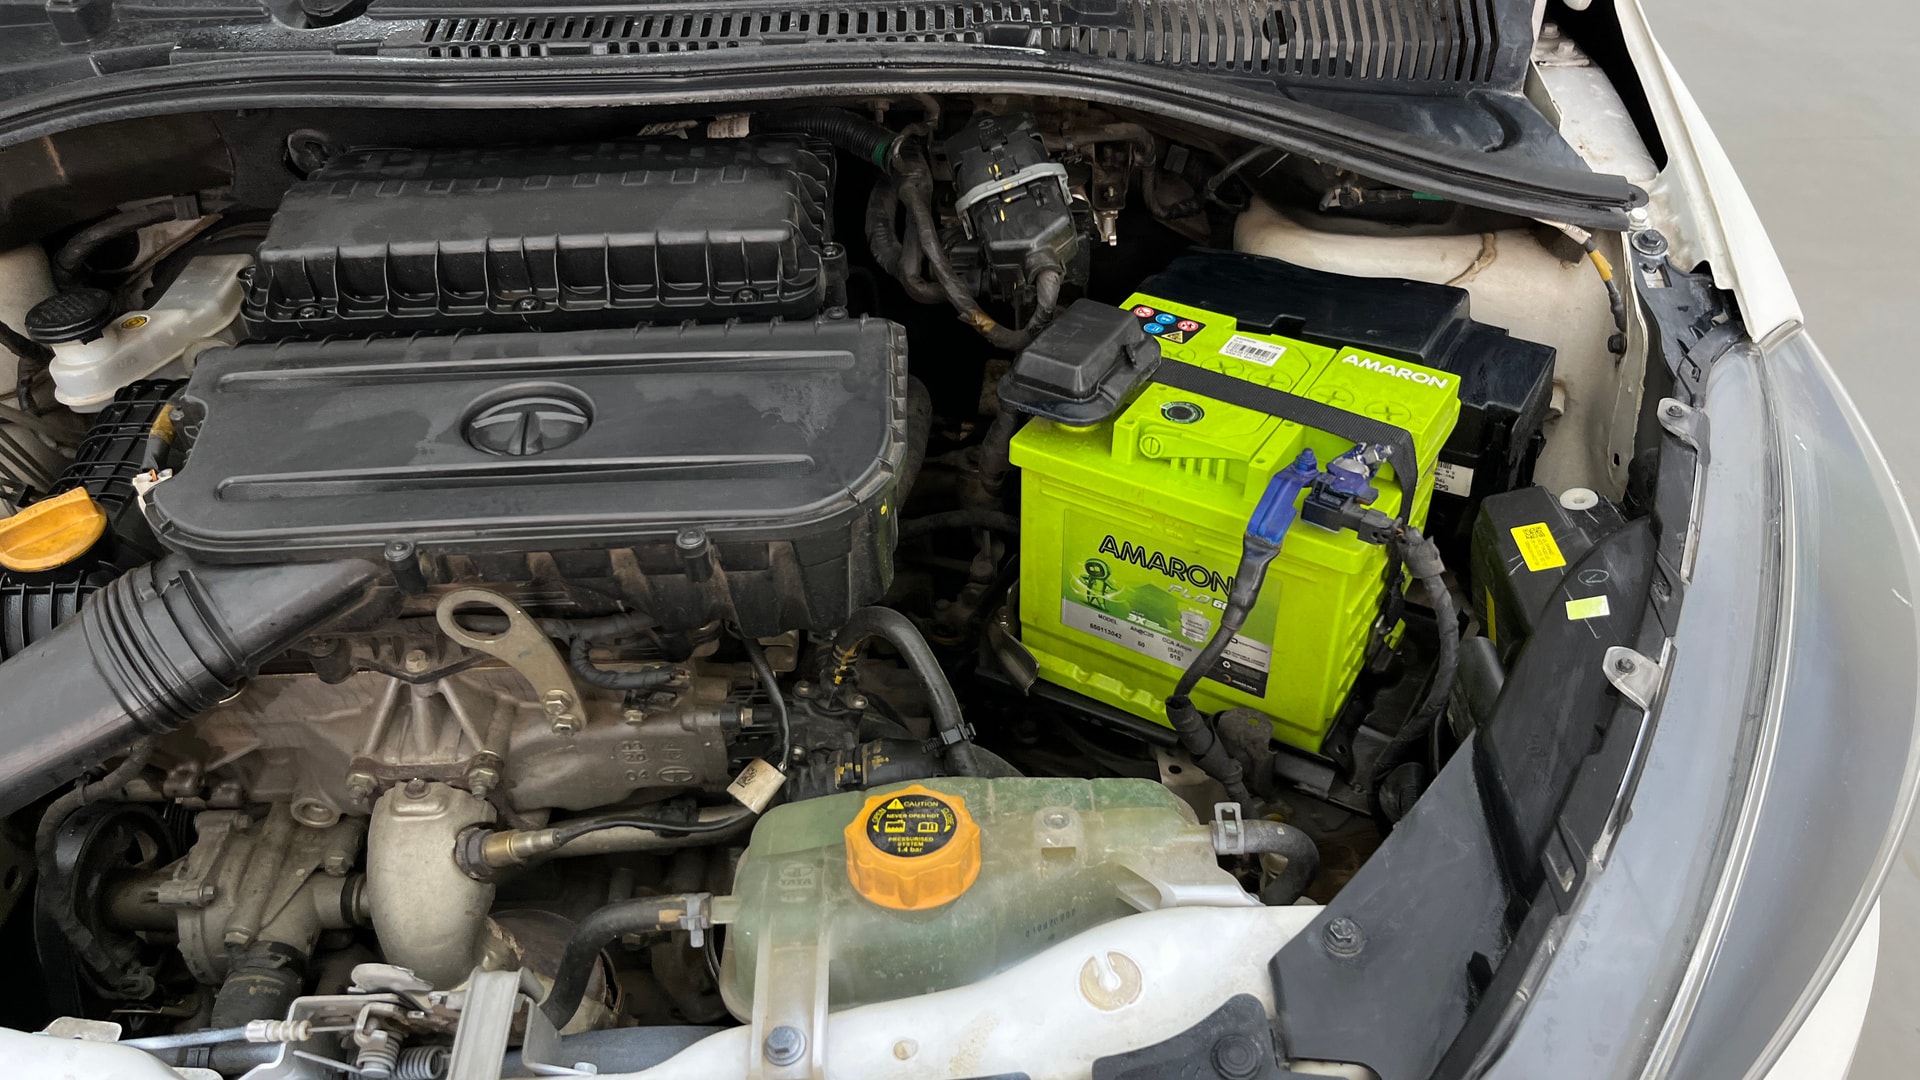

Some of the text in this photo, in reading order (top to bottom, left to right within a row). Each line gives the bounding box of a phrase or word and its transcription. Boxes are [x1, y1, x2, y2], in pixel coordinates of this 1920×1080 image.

[1342, 353, 1448, 389] AMARON
[1099, 535, 1235, 597] AMARON
[1168, 583, 1211, 605] FLO
[1098, 613, 1118, 625] MODEL
[872, 808, 887, 823] OPEN
